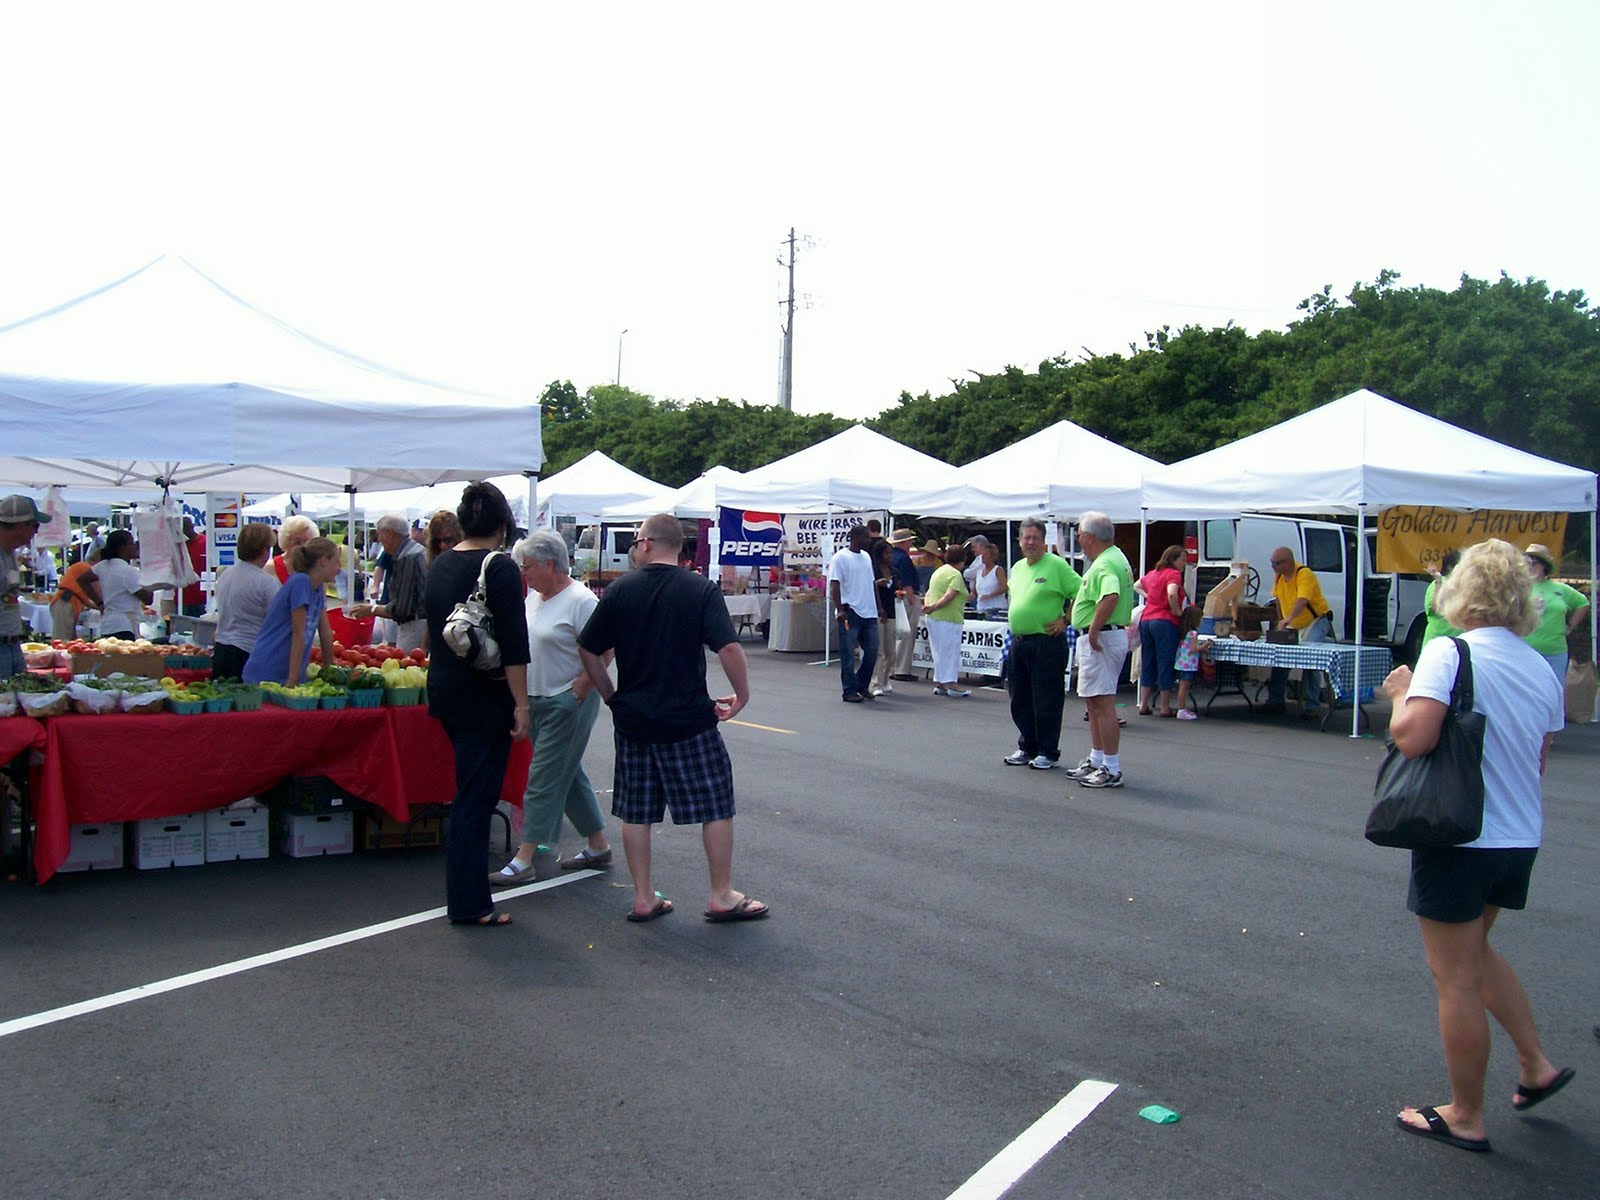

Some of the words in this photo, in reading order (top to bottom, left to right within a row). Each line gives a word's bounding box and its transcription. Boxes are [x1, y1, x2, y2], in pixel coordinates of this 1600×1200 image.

[1382, 505, 1458, 537] Golden
[1466, 509, 1562, 534] Harvest
[797, 532, 818, 544] BEE
[721, 541, 783, 557] PEPSI
[961, 631, 1003, 647] FARMS
